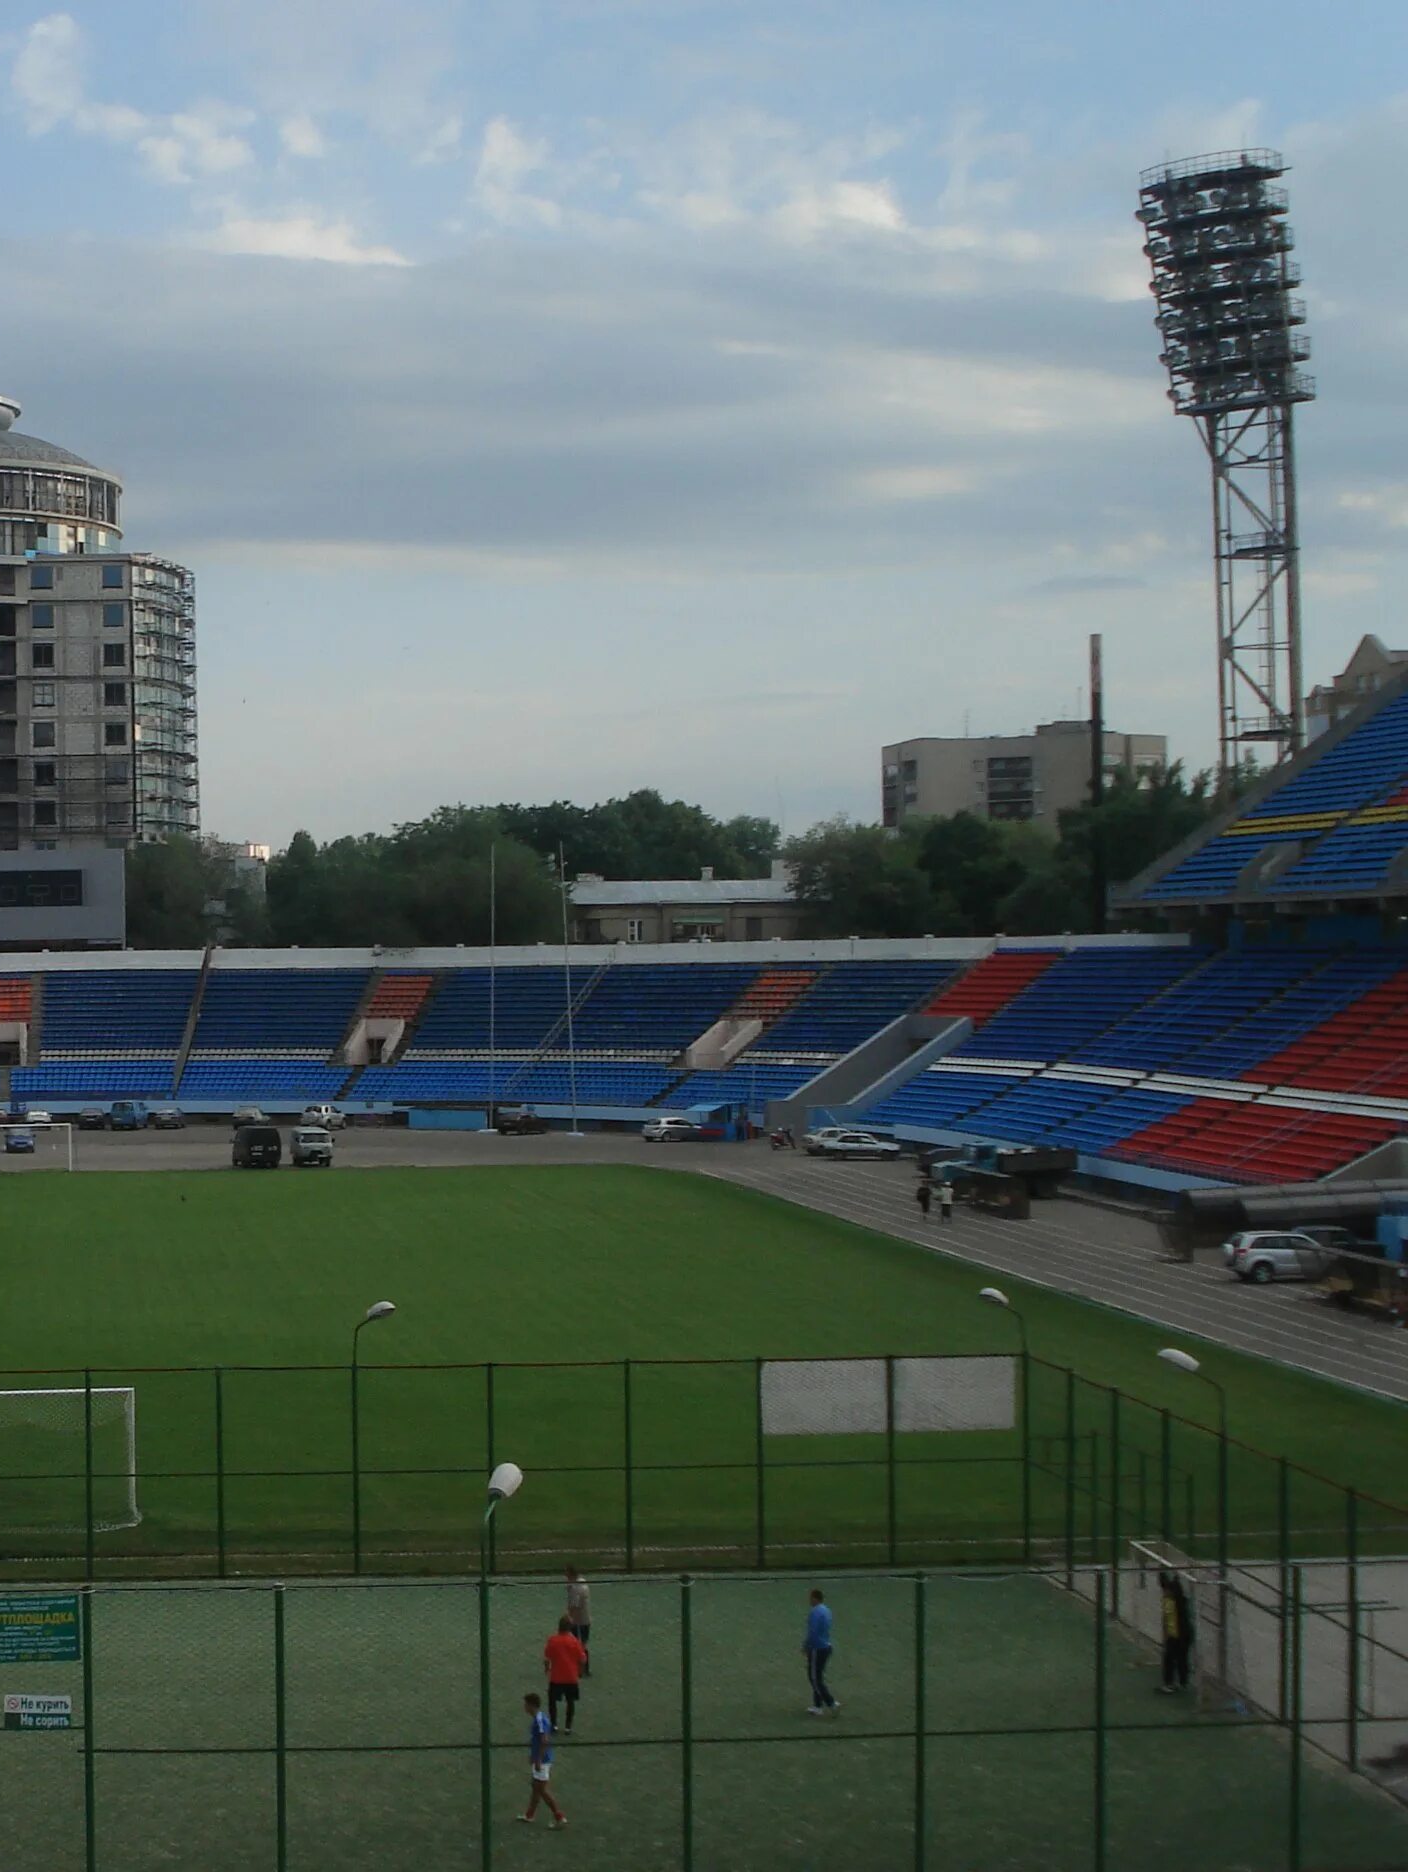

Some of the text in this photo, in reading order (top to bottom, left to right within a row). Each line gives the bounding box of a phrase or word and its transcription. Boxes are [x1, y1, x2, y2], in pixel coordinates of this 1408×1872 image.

[21, 1697, 69, 1712] Не курить
[21, 1713, 69, 1728] Не сорить
